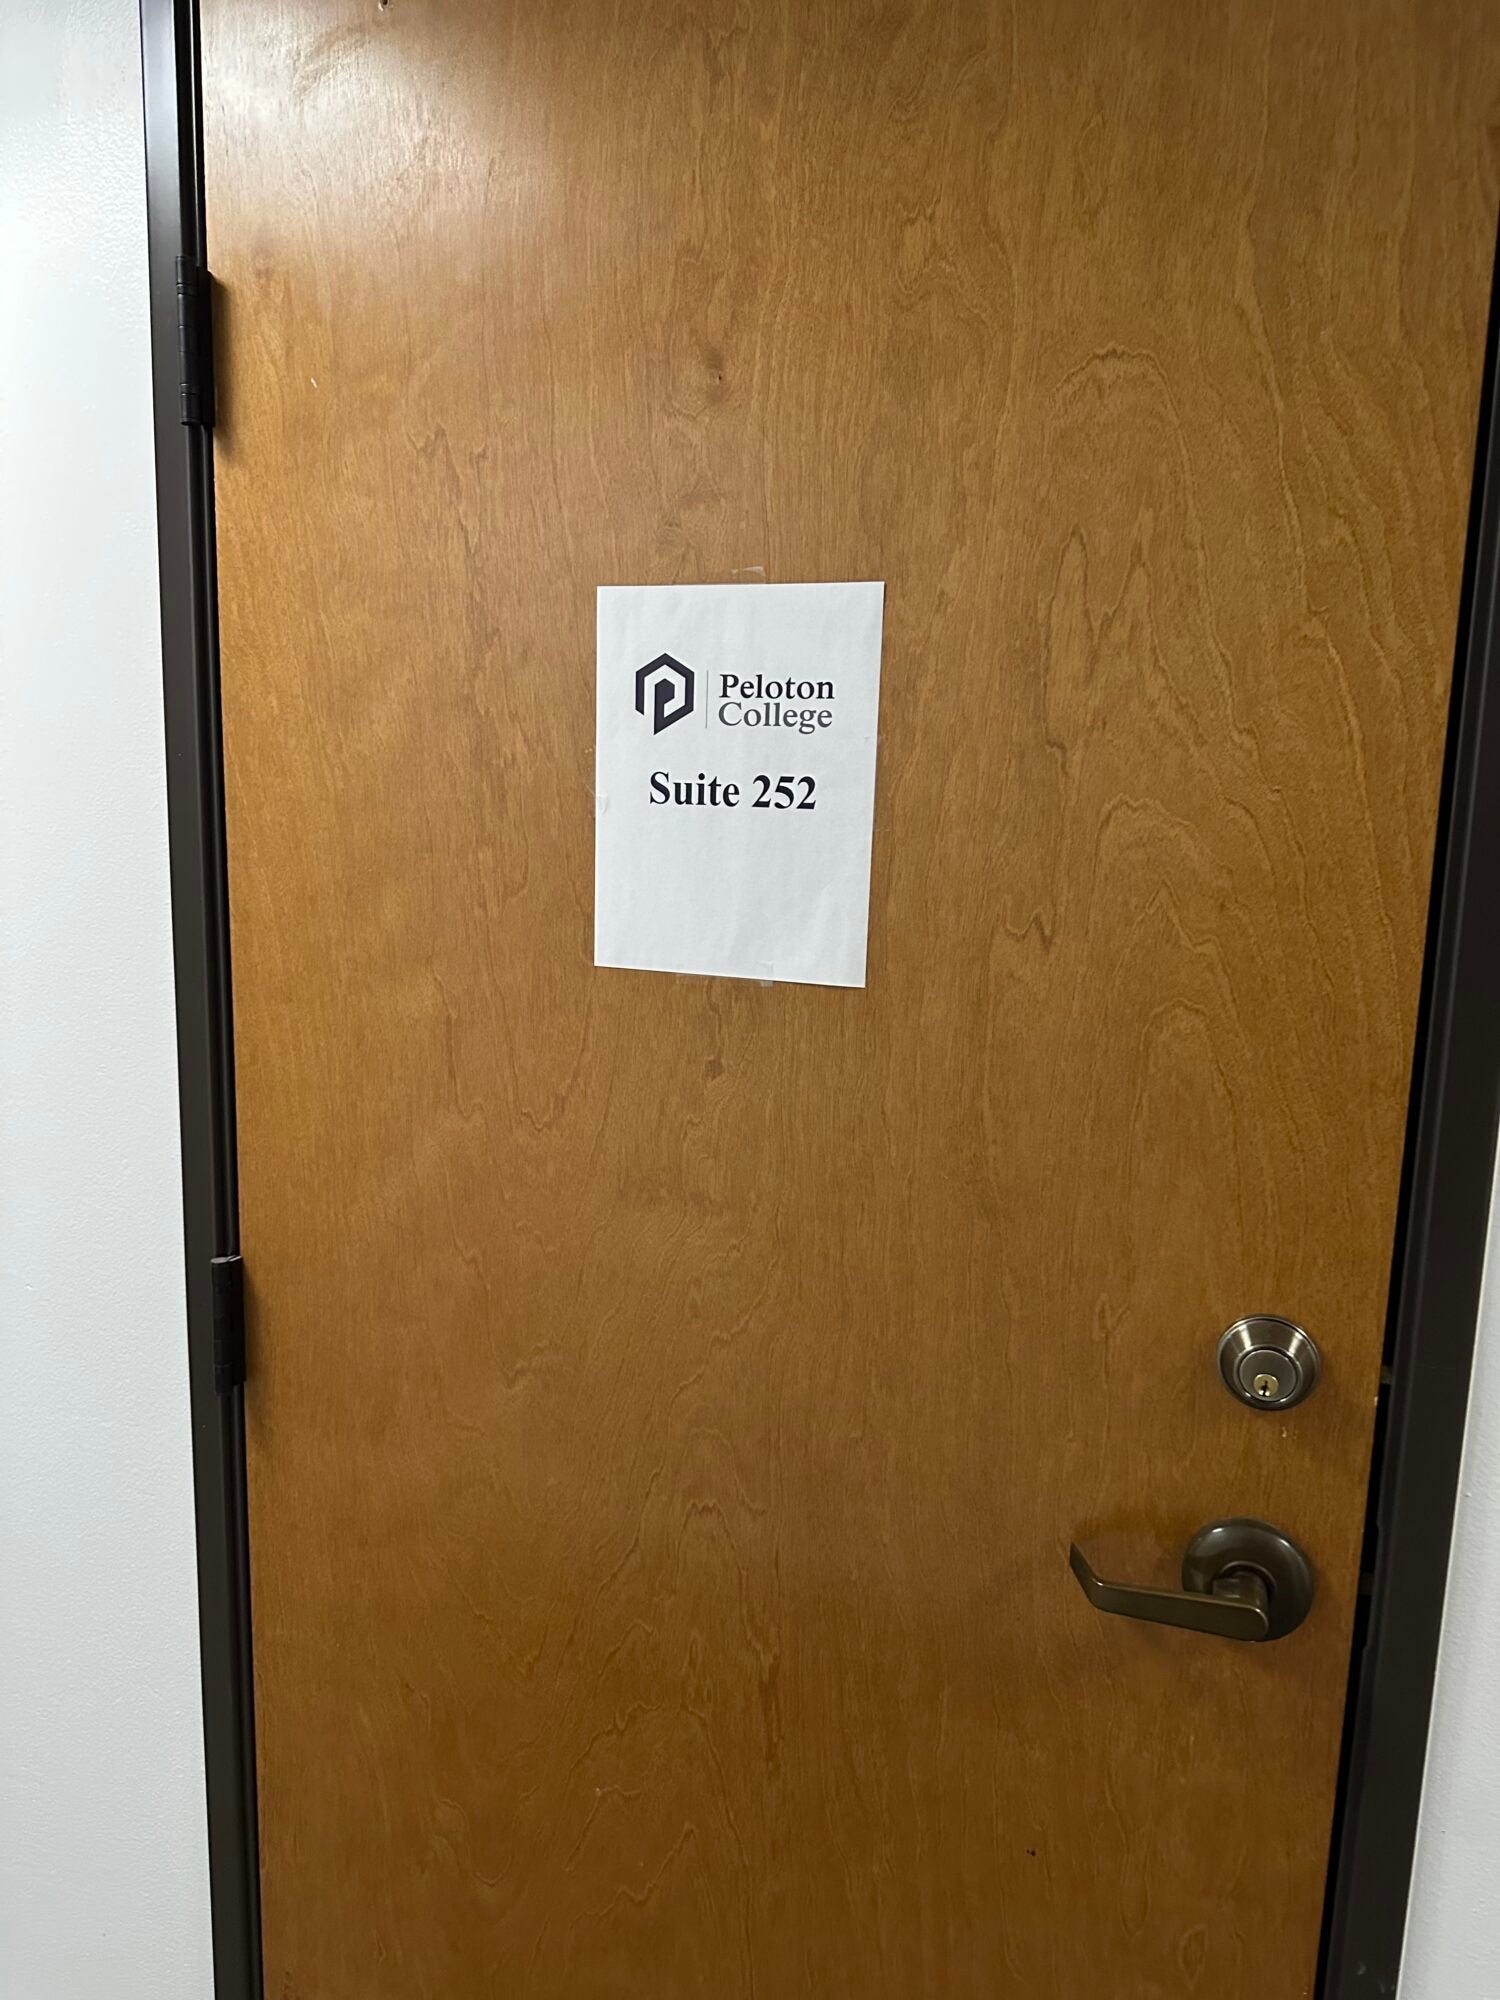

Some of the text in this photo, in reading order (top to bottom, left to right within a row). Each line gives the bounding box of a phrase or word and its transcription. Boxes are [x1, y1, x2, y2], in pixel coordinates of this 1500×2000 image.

[719, 673, 835, 700] Peloton
[718, 701, 833, 735] College
[649, 771, 817, 810] Suite 252
